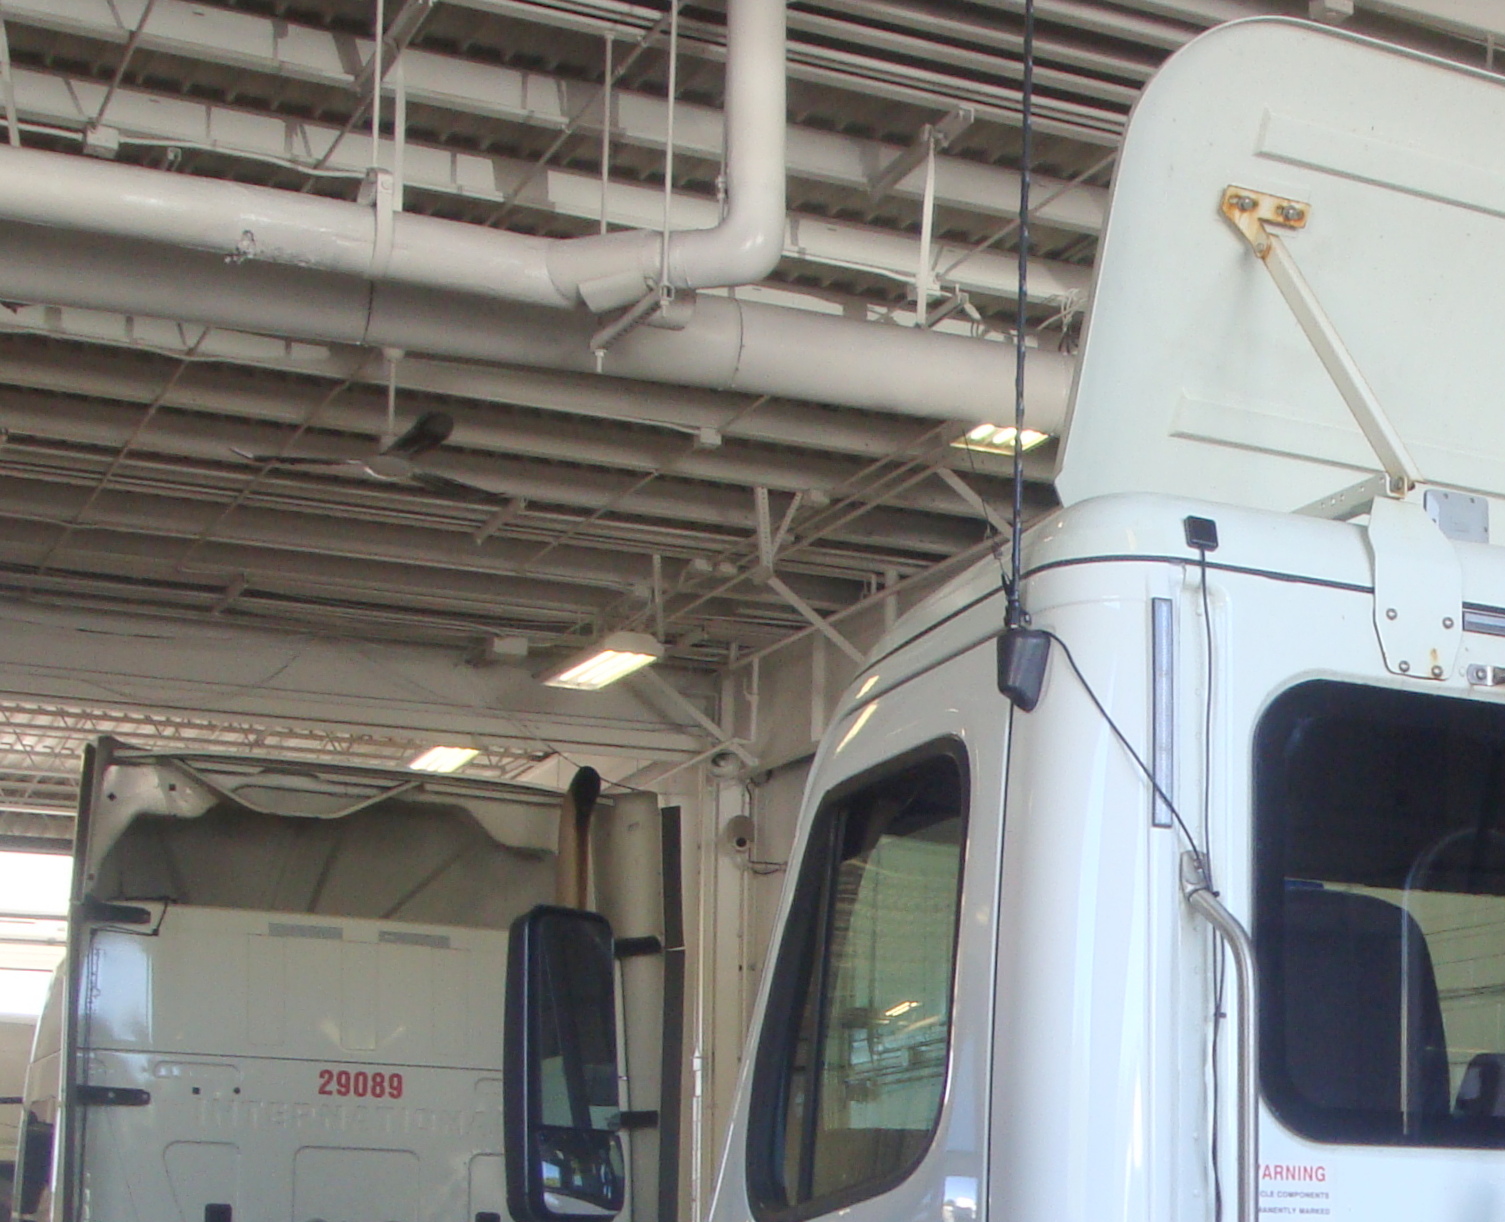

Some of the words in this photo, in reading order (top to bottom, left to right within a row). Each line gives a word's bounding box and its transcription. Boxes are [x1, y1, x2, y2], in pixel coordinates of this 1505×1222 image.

[318, 1069, 403, 1099] 29089
[1257, 1164, 1327, 1182] ARNING
[1276, 1190, 1330, 1200] COMPONENTS
[1258, 1206, 1296, 1215] ANENTLY
[1298, 1207, 1331, 1216] MARKED
